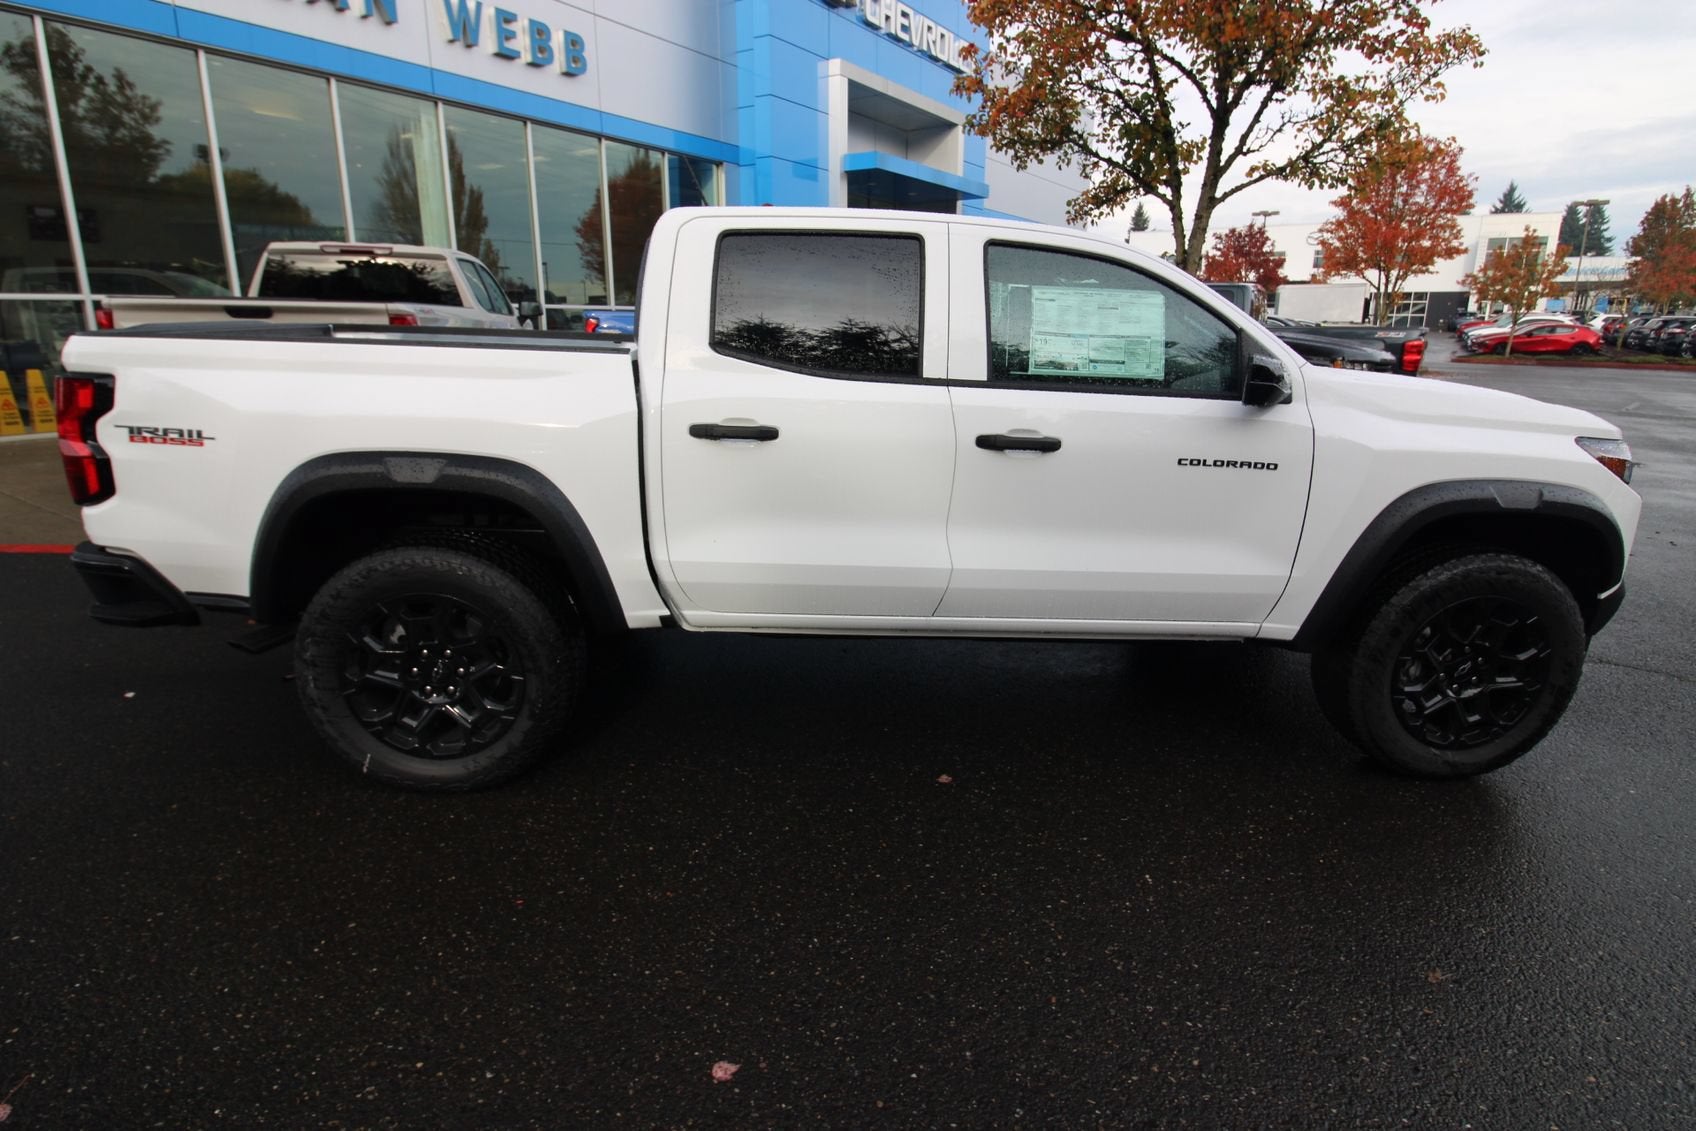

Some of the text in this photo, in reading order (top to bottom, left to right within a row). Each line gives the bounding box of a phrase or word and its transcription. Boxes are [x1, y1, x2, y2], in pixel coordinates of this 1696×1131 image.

[441, 0, 588, 76] WEBB
[863, 0, 979, 77] CHEVROLE
[114, 425, 216, 440] TRAIL
[129, 435, 204, 447] BOSS
[1177, 458, 1279, 471] COLORADO
